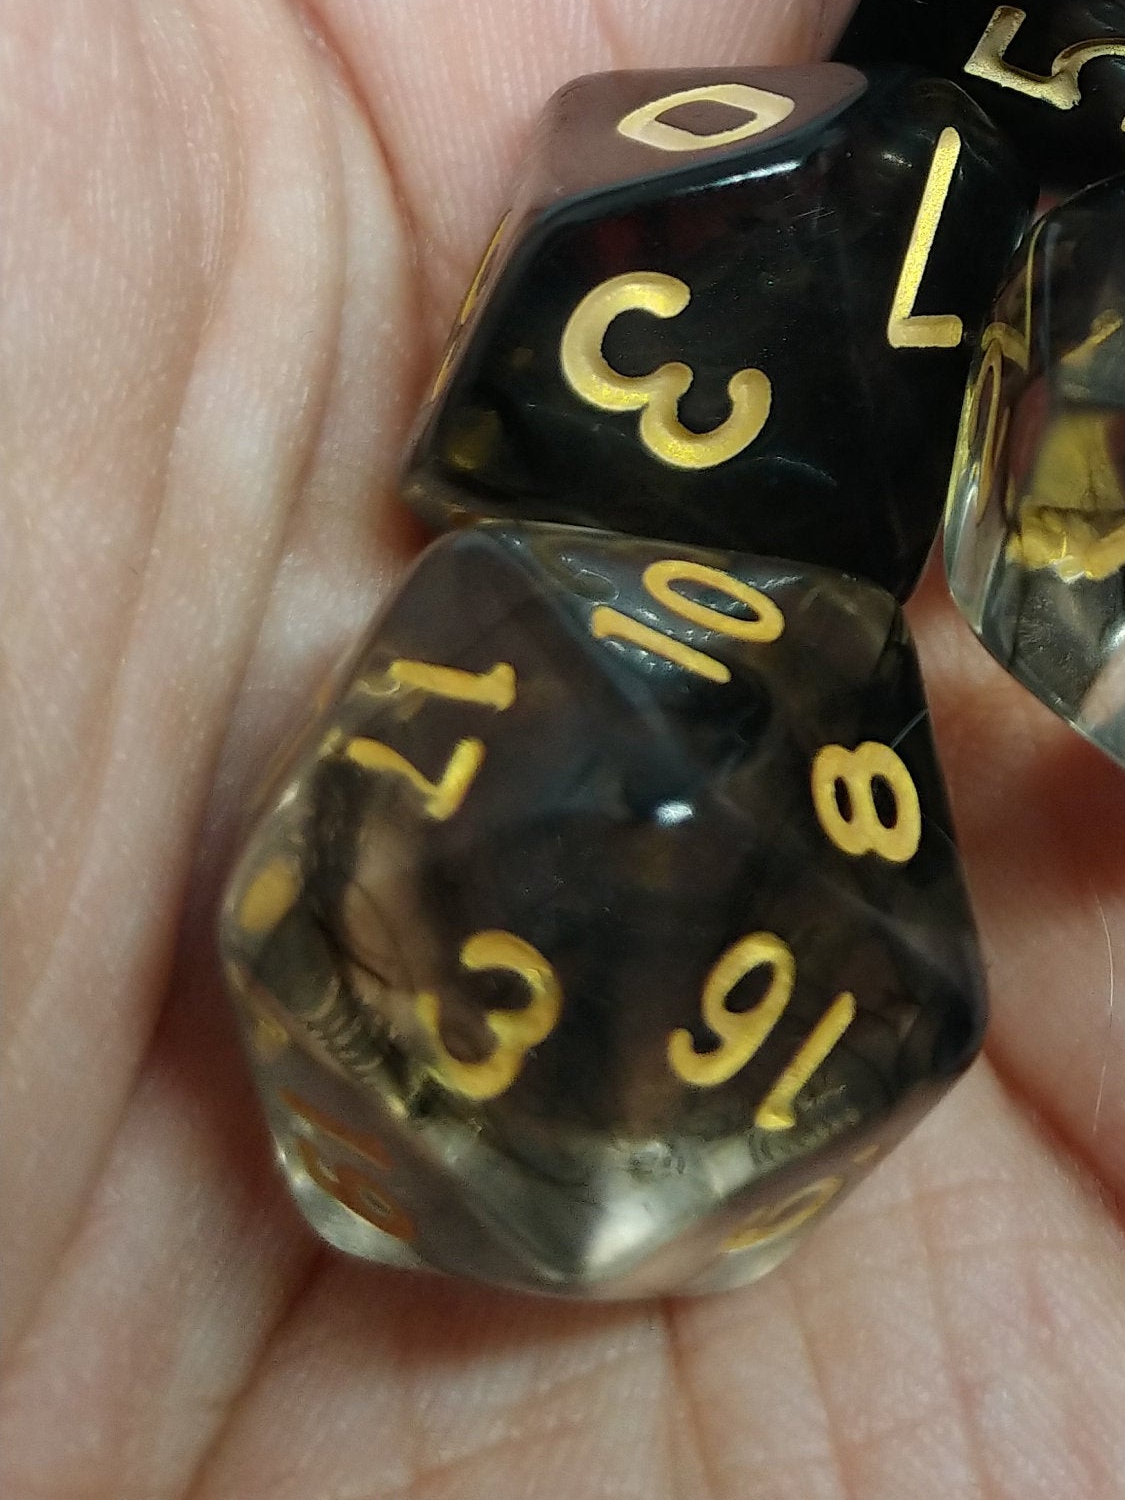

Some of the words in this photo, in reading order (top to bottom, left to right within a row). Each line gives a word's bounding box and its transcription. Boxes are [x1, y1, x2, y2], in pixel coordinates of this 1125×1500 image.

[617, 82, 796, 152] 0
[887, 125, 963, 349] 7
[560, 270, 772, 469] 3
[590, 559, 786, 684] 10
[346, 657, 517, 821] 17
[811, 740, 921, 863] 8
[415, 929, 564, 1101] 3
[667, 931, 857, 1130] 16
